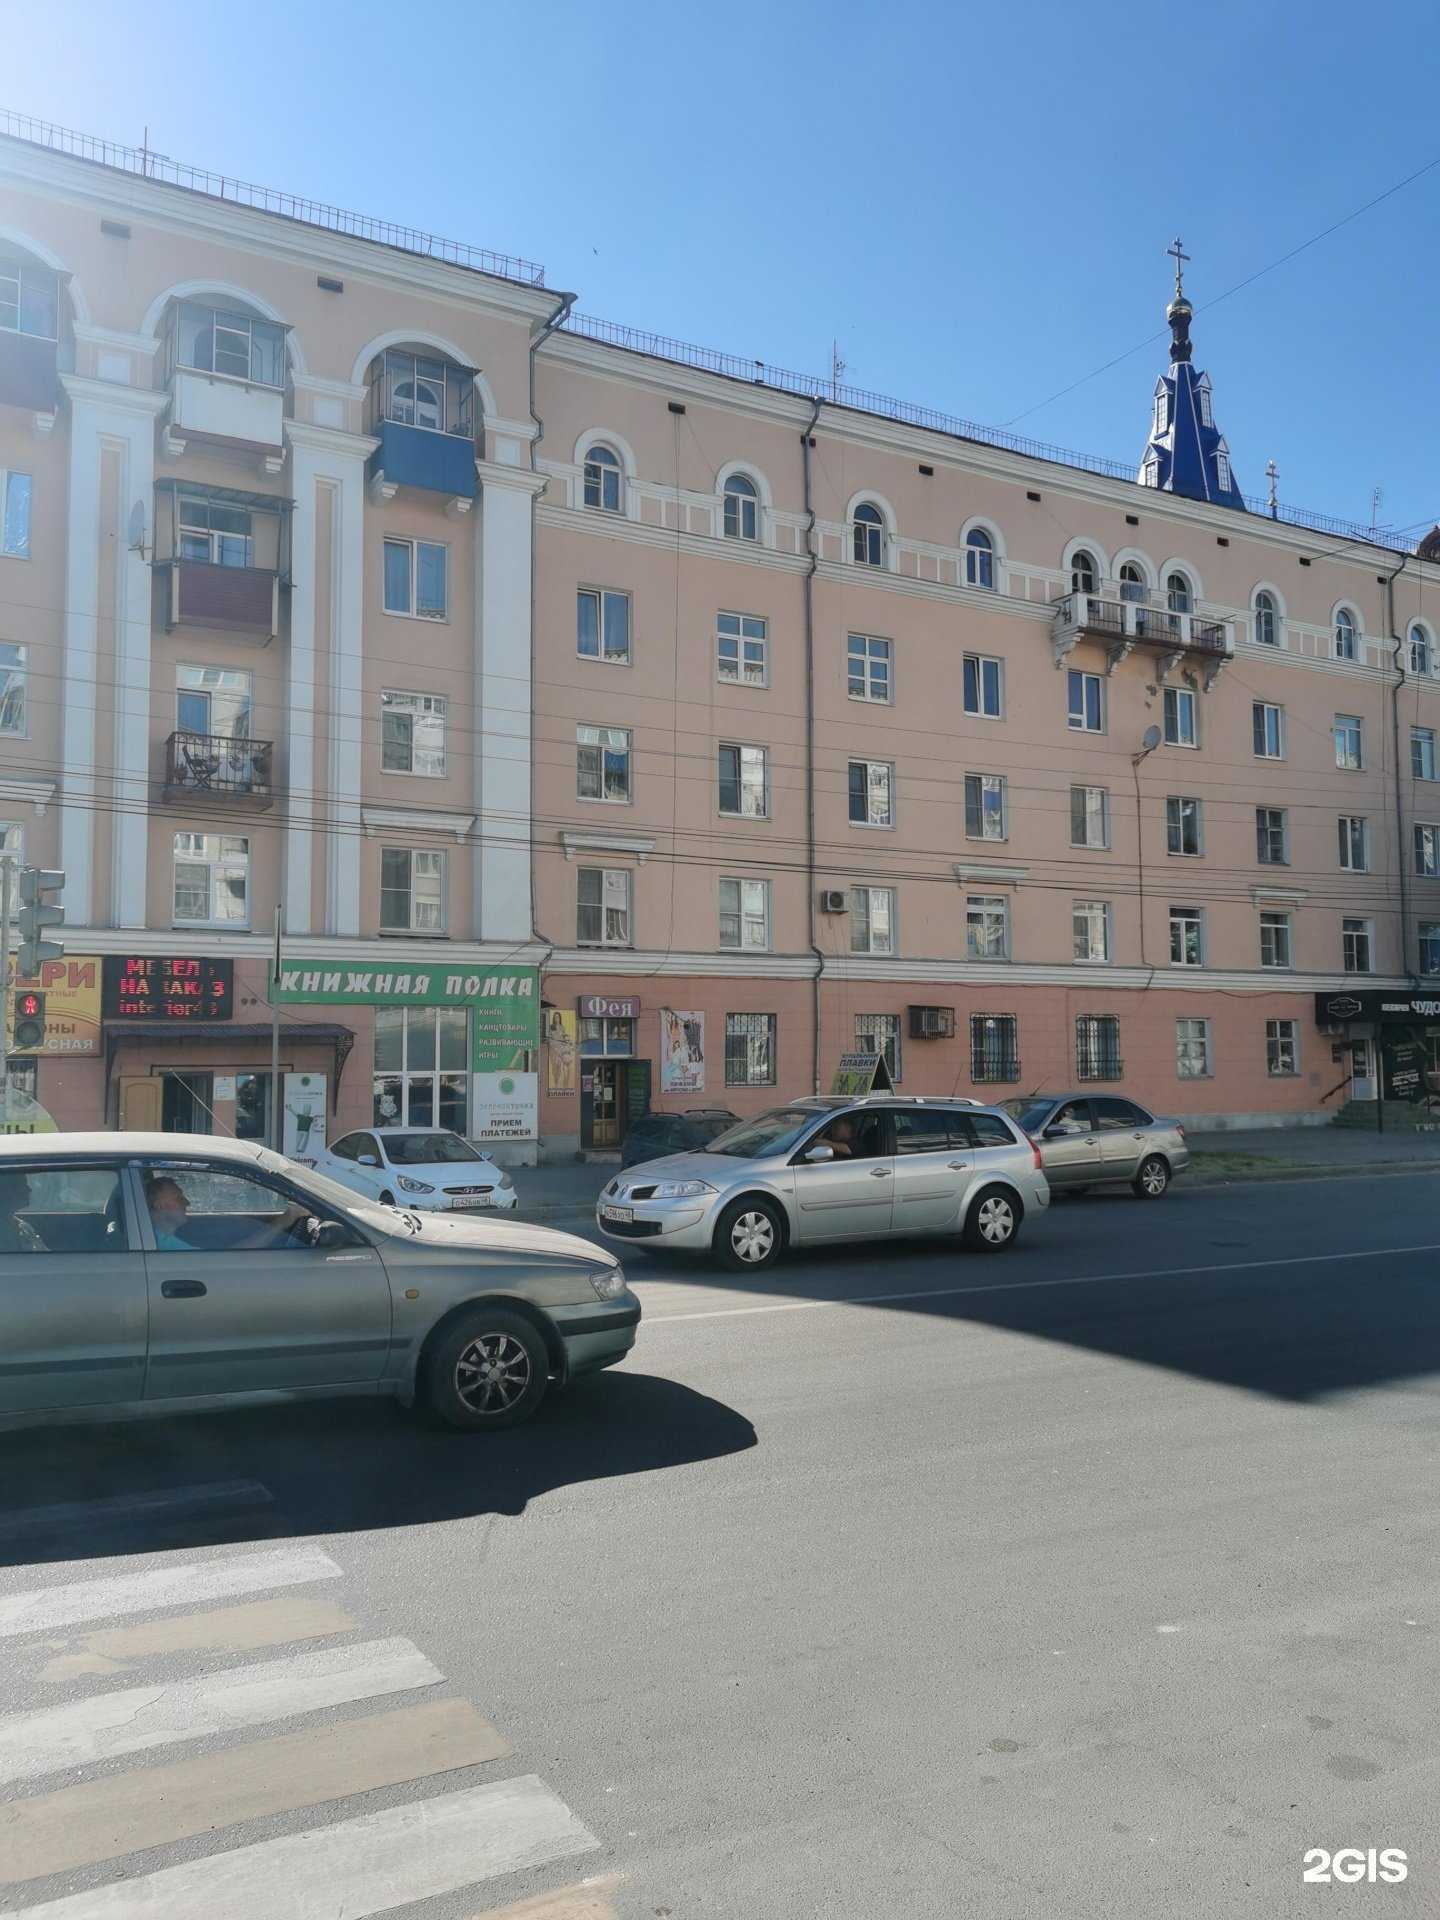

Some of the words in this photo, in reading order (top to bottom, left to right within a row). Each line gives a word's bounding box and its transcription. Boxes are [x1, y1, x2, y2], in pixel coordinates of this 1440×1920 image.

[280, 971, 431, 995] КНИЖНАЯ
[445, 975, 533, 997] ПОЛКА
[588, 997, 632, 1017] Фея
[840, 1059, 878, 1068] ПЛАВКИ
[490, 1119, 522, 1127] ПРИЕМ
[480, 1128, 532, 1137] ПЛАТЕЖЕЙ
